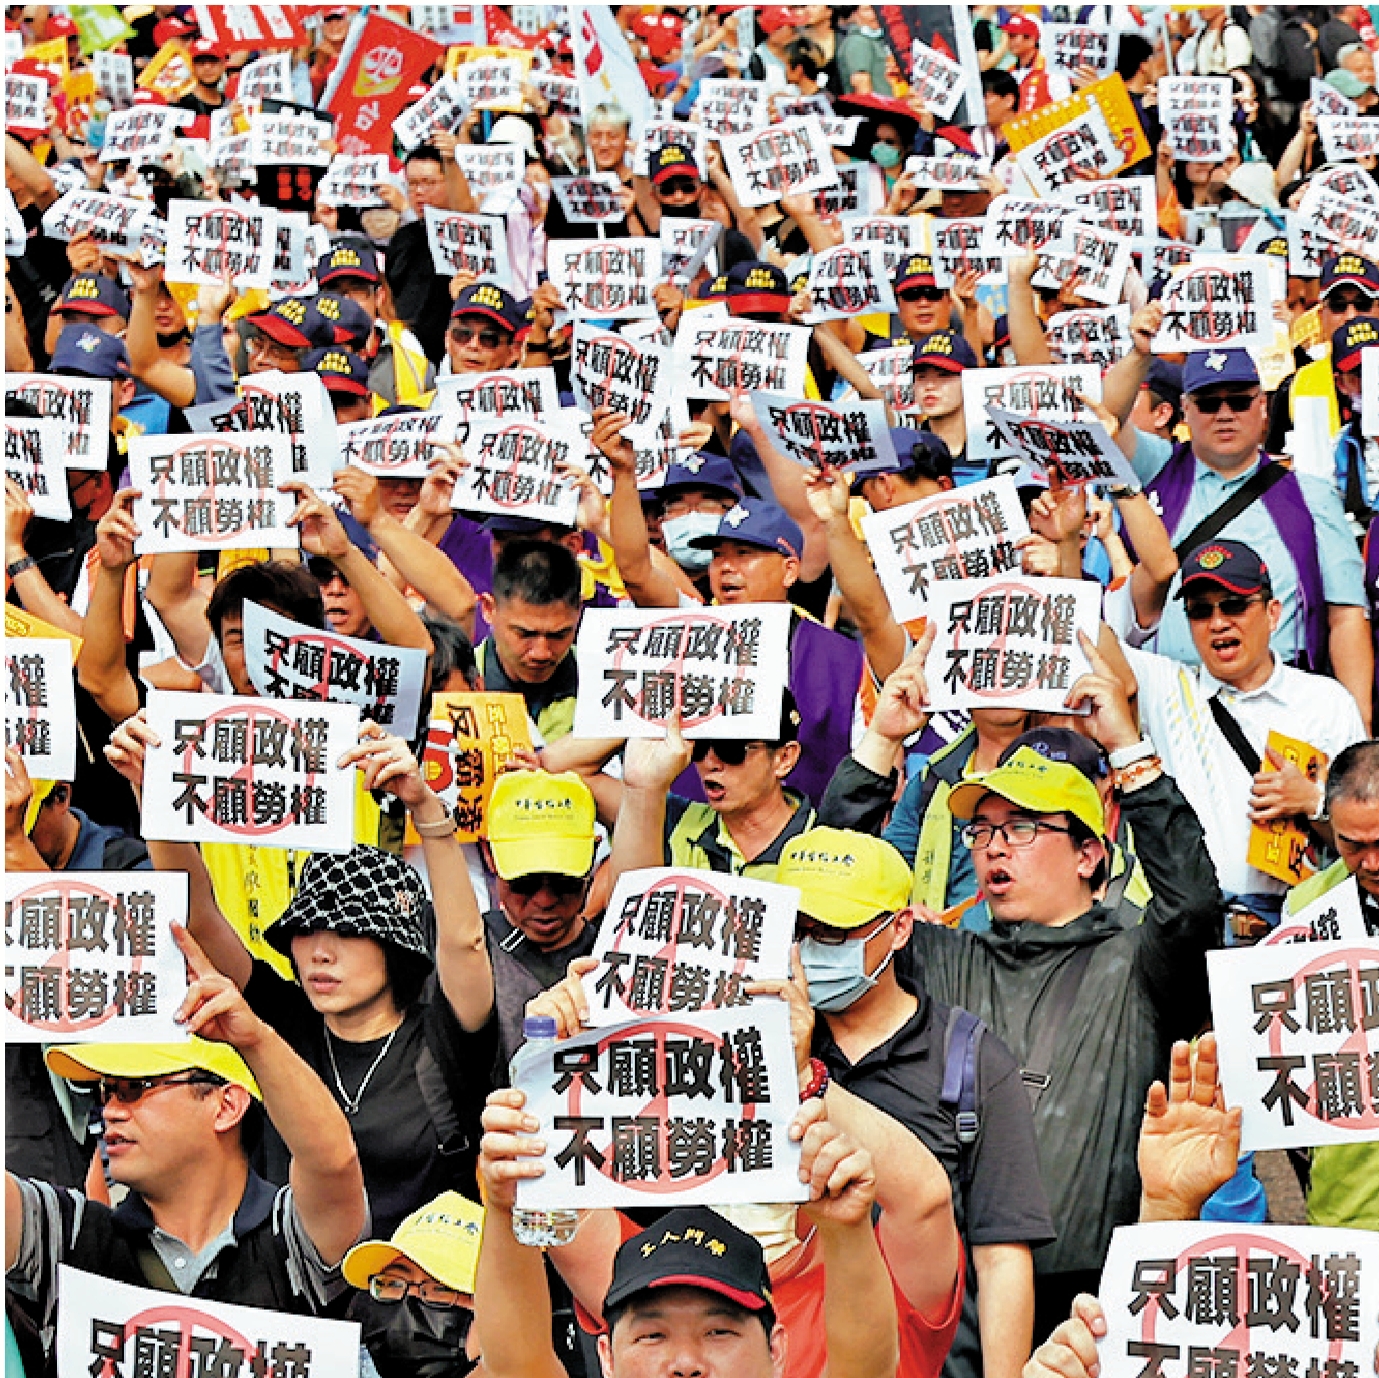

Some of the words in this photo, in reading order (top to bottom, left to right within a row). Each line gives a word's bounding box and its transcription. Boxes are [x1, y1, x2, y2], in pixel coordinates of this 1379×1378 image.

[695, 329, 790, 359] 只顧政權
[691, 355, 786, 391] 不顧勞權
[150, 443, 272, 489] 只顧政權
[151, 499, 276, 538] 不顧勞權
[890, 491, 1008, 555] 只顧政權
[606, 616, 762, 668] 只顧政權
[947, 594, 1076, 648] 只顧政權
[263, 628, 400, 697] 只顧政權
[943, 646, 1071, 696] 不顧勞權
[601, 669, 756, 720] 不顧勞權
[173, 716, 329, 775] 只顧政權
[171, 773, 328, 826] 不顧勞權
[615, 891, 767, 963] 只顧政權
[552, 1027, 770, 1103] 只顧政權
[553, 1117, 773, 1186] 不顧勞權
[1127, 1253, 1362, 1345] 只顧政權
